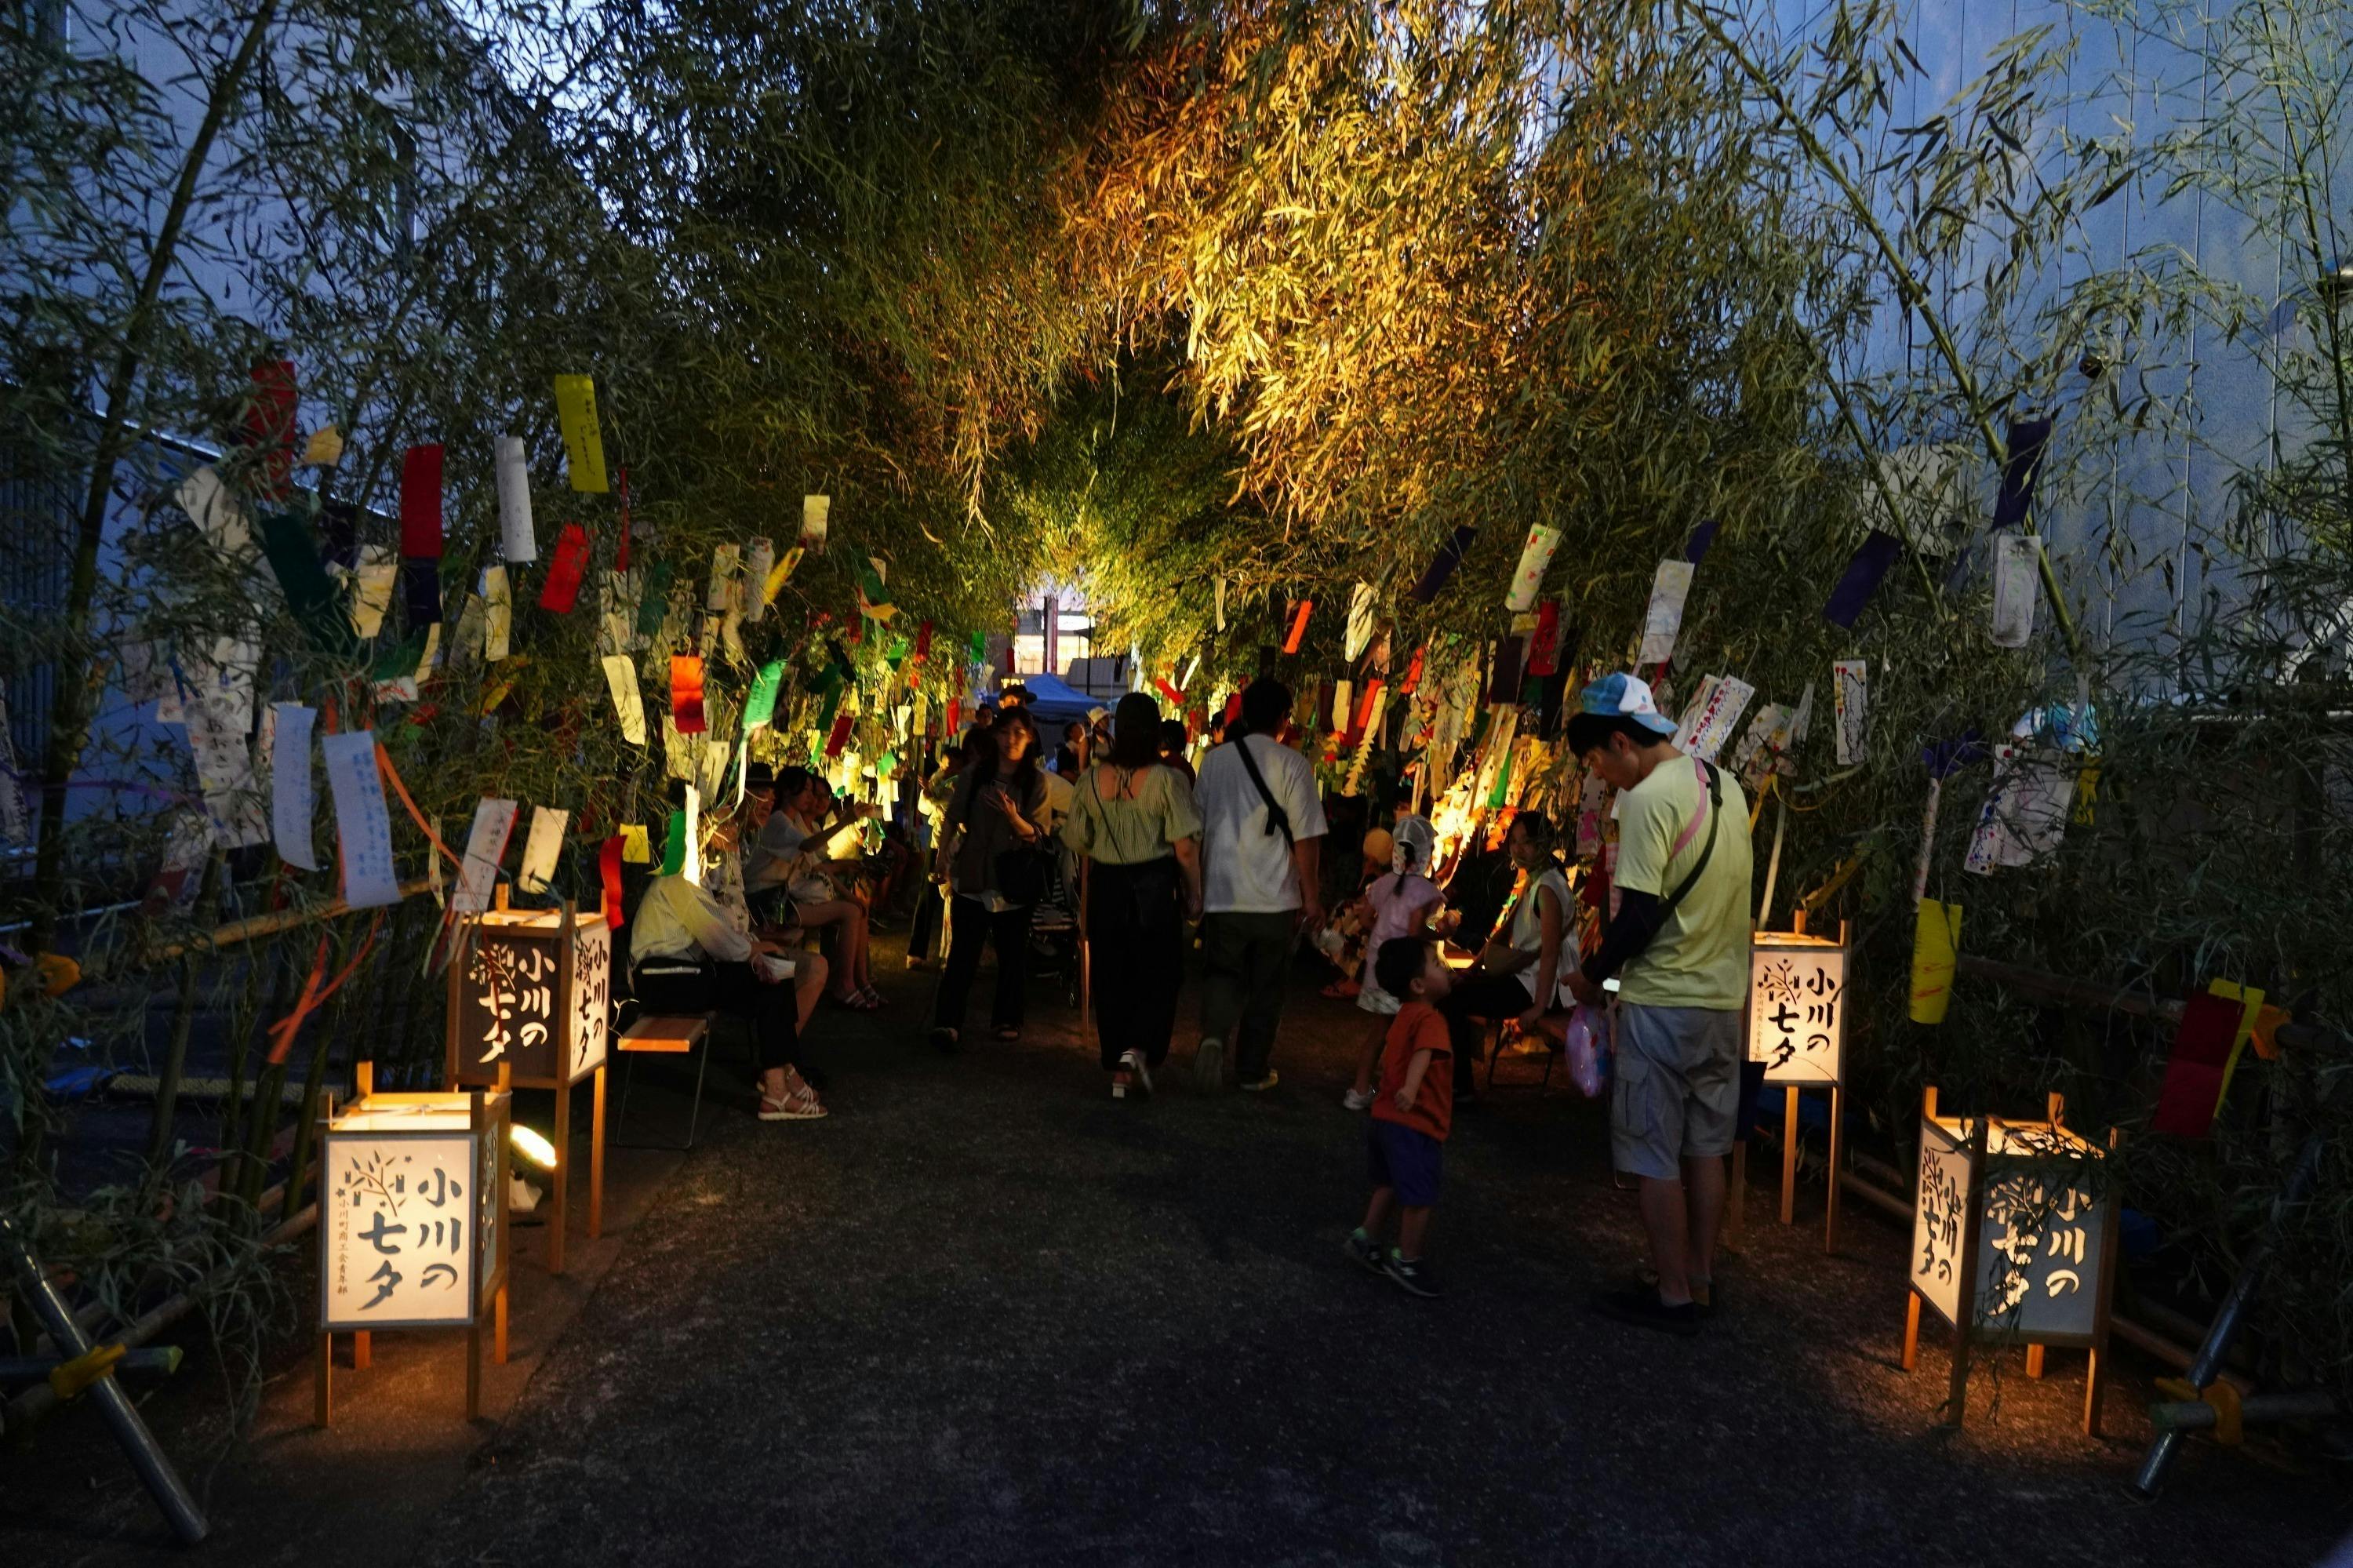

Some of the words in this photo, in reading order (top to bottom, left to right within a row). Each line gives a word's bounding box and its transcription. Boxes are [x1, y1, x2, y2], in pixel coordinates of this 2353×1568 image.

[478, 980, 517, 1064] 七夕
[518, 947, 556, 1047] 小川の
[578, 988, 592, 1069] 七夕
[594, 940, 609, 1039] 小川の
[1768, 1002, 1801, 1070] 七夕
[1806, 967, 1836, 1054] 小川の
[357, 1210, 408, 1312] 七夕
[417, 1166, 463, 1291] 小川の
[1918, 1196, 1940, 1275] 七夕
[1938, 1176, 1962, 1286] 小川の
[1988, 1220, 2038, 1315] 七夕
[2046, 1186, 2093, 1298] 小川の
